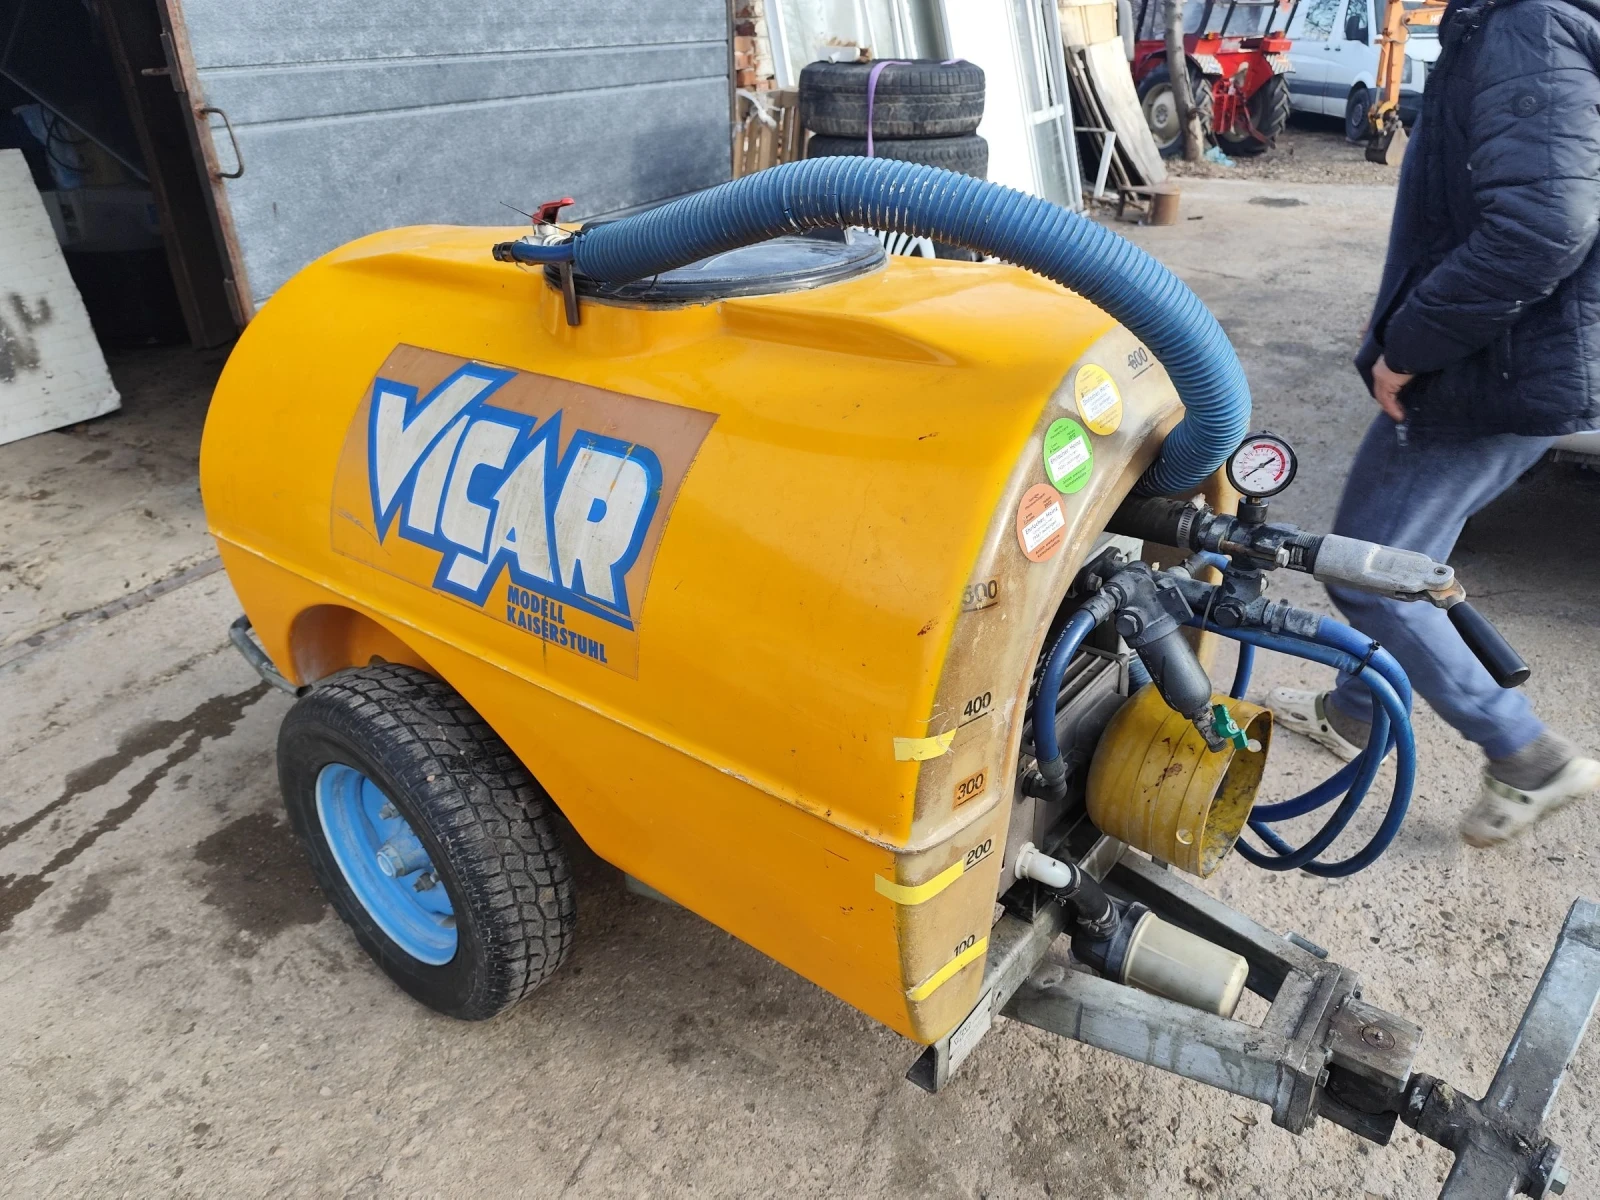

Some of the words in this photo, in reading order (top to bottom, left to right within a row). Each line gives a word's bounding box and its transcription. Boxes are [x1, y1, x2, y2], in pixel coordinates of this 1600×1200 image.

[1128, 347, 1149, 371] 600
[369, 362, 661, 628] VICAR
[507, 585, 566, 625] MODELL
[507, 606, 608, 663] KAISERSTUHL
[963, 692, 992, 717] 400
[955, 774, 985, 801] 300
[966, 838, 992, 866] 200
[953, 934, 976, 958] 100
